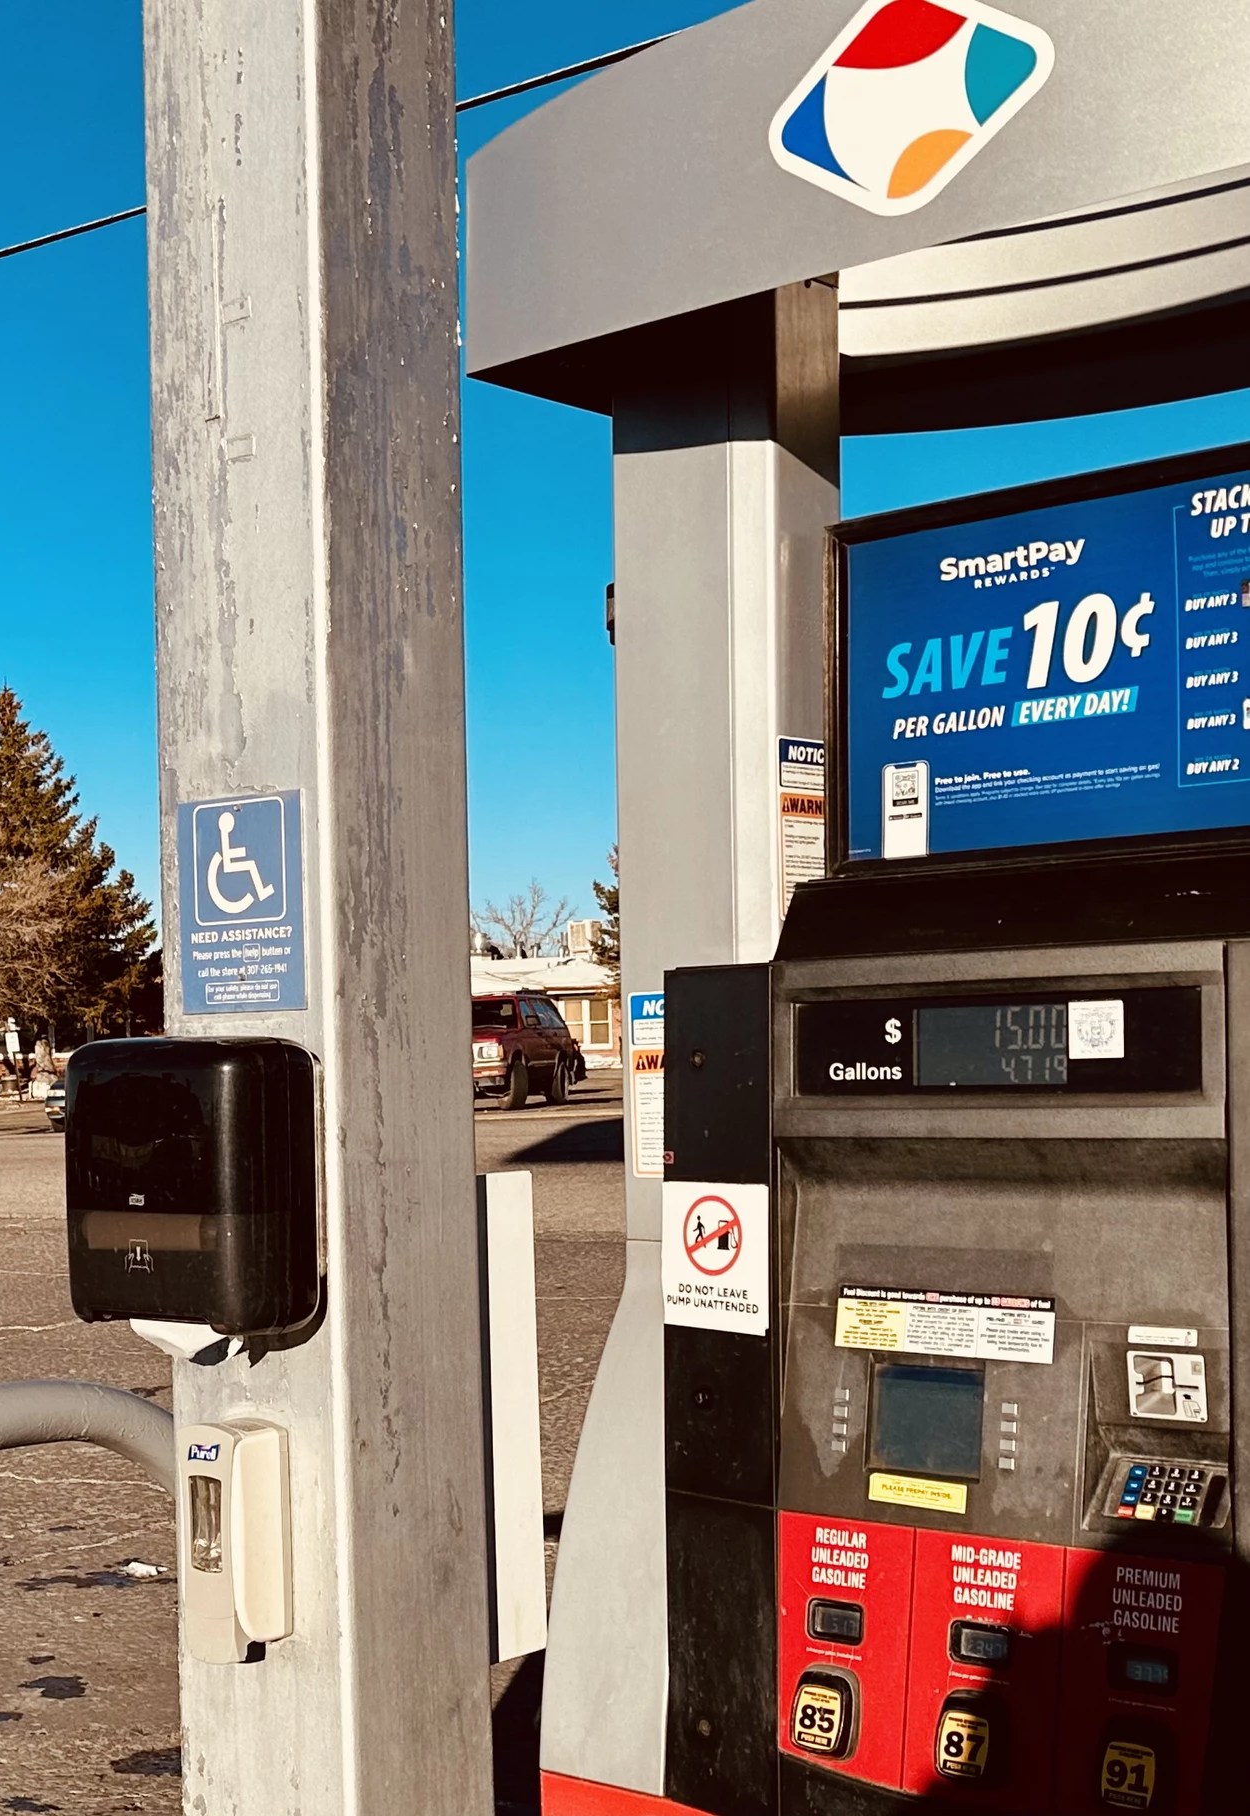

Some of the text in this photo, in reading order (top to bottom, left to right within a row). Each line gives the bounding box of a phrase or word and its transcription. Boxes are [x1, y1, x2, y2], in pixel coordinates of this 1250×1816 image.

[1210, 516, 1238, 539] UP
[939, 538, 1085, 583] SmartPay
[1184, 597, 1207, 612] BUY
[1207, 593, 1230, 609] ANY
[1230, 592, 1238, 605] 3
[882, 591, 1155, 699] SAVE 10¢
[1185, 636, 1208, 650] BUY
[1208, 631, 1231, 647] ANY
[1230, 631, 1238, 644] 3
[1185, 674, 1209, 689] BUY
[1208, 671, 1231, 686] ANY
[1231, 670, 1239, 683] 3
[892, 688, 1131, 741] PER GALLON EVERY DAY!
[1186, 713, 1236, 730] BUY ANY 3
[934, 777, 953, 785] Free
[964, 773, 982, 784] join.
[983, 771, 1002, 780] Free
[1013, 768, 1031, 776] use.
[1186, 761, 1209, 775] BUY
[1208, 759, 1232, 773] ANY
[1231, 758, 1240, 771] 2
[190, 926, 293, 945] NEED ASSISTANCE?
[192, 950, 213, 961] Please
[213, 950, 231, 961] press
[231, 949, 243, 959] the
[284, 946, 292, 955] or
[198, 968, 209, 978] call
[210, 967, 221, 977] the
[221, 966, 238, 976] store
[884, 1017, 902, 1045] $
[994, 1004, 1067, 1050] 15.00
[828, 1062, 902, 1081] Gallons
[678, 1282, 749, 1300] DO NOT LEAVE
[666, 1294, 760, 1315] PUMP UNATTENDED
[190, 1445, 217, 1460] Purell
[815, 1526, 867, 1549] REGULAR
[811, 1546, 869, 1570] UNLEADED
[951, 1544, 1022, 1571] MID-GRADE
[811, 1566, 866, 1590] GASOLINE
[952, 1565, 1017, 1590] UNLEADED
[1116, 1566, 1181, 1590] PREMIUM
[953, 1585, 1015, 1611] GASOLINE
[1112, 1587, 1183, 1613] UNLEADED
[1113, 1609, 1180, 1634] GASOLINE
[798, 1703, 836, 1734] 85
[943, 1730, 986, 1763] 87
[1105, 1758, 1149, 1794] 91
